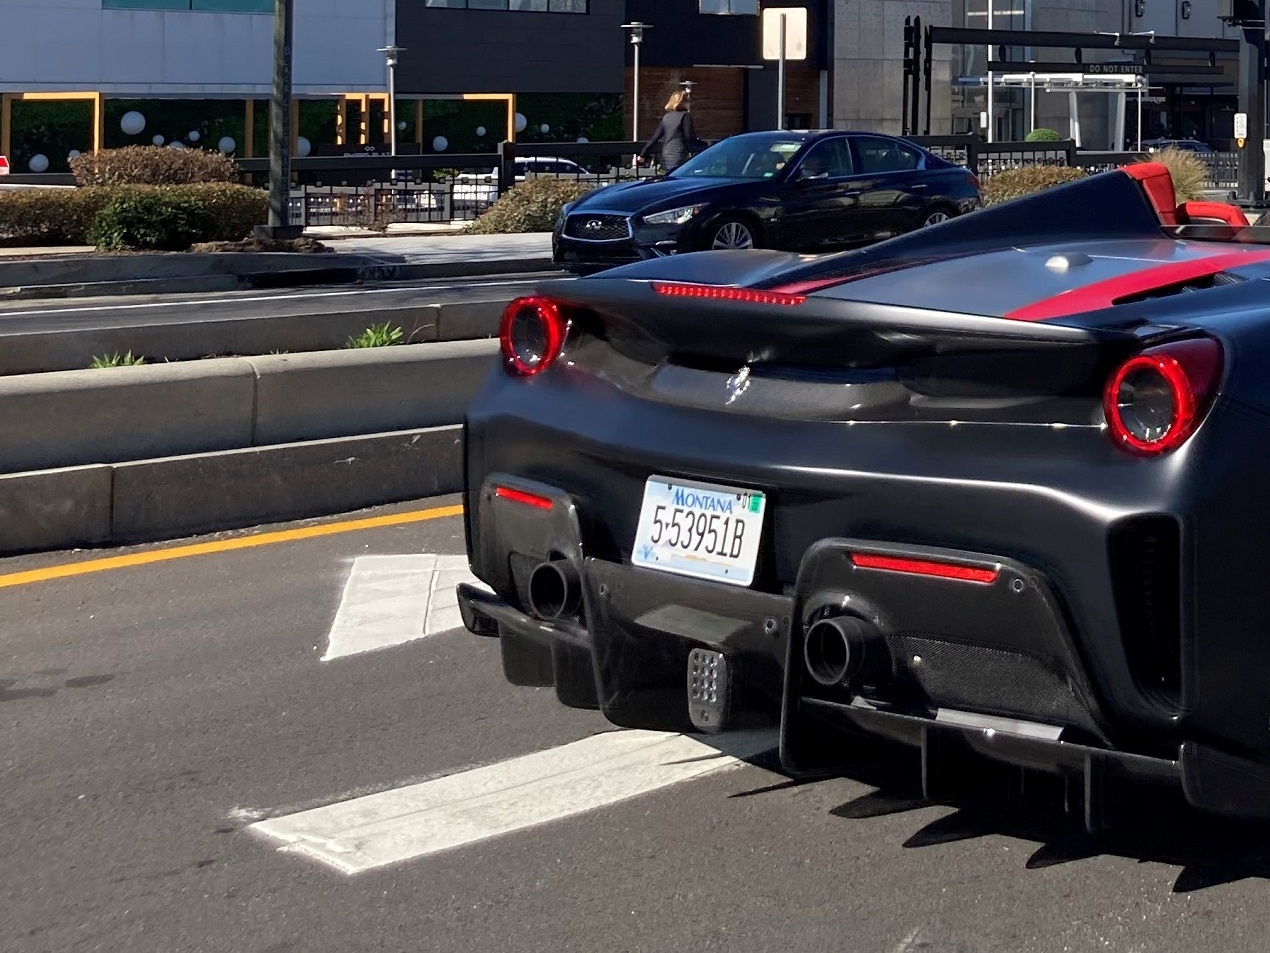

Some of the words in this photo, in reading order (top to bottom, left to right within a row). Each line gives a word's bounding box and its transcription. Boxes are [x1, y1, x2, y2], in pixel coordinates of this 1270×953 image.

[1089, 65, 1101, 73] DO
[1103, 65, 1118, 73] NOT
[1120, 65, 1143, 73] ENTER
[672, 488, 734, 514] MONTANA
